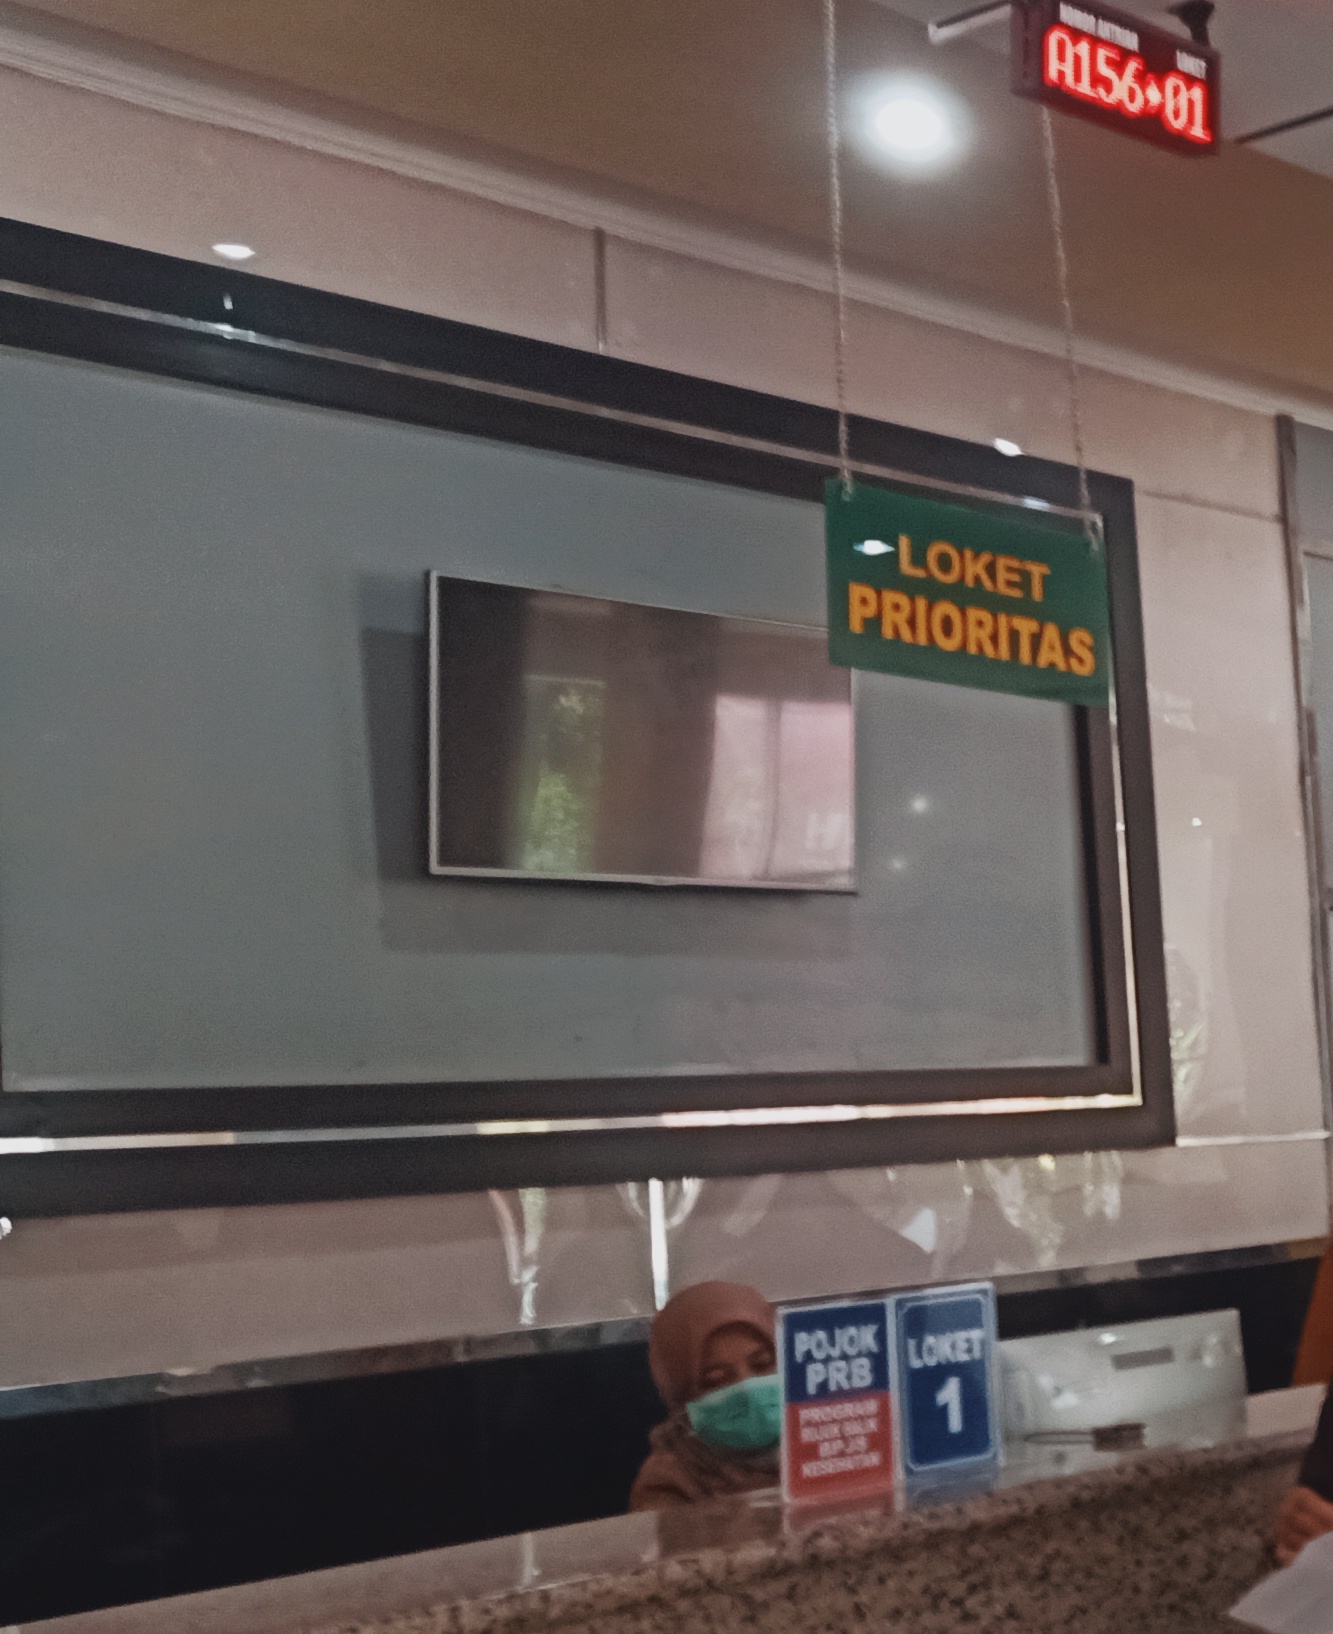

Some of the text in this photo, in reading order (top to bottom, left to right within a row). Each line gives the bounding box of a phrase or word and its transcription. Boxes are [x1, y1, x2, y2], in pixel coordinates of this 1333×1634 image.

[898, 533, 1051, 602] LOKET
[848, 582, 1096, 677] PRIORITAS
[794, 1323, 880, 1363] POJOK
[906, 1327, 985, 1369] LOKET
[806, 1357, 873, 1395] PRB
[935, 1376, 963, 1434] 1
